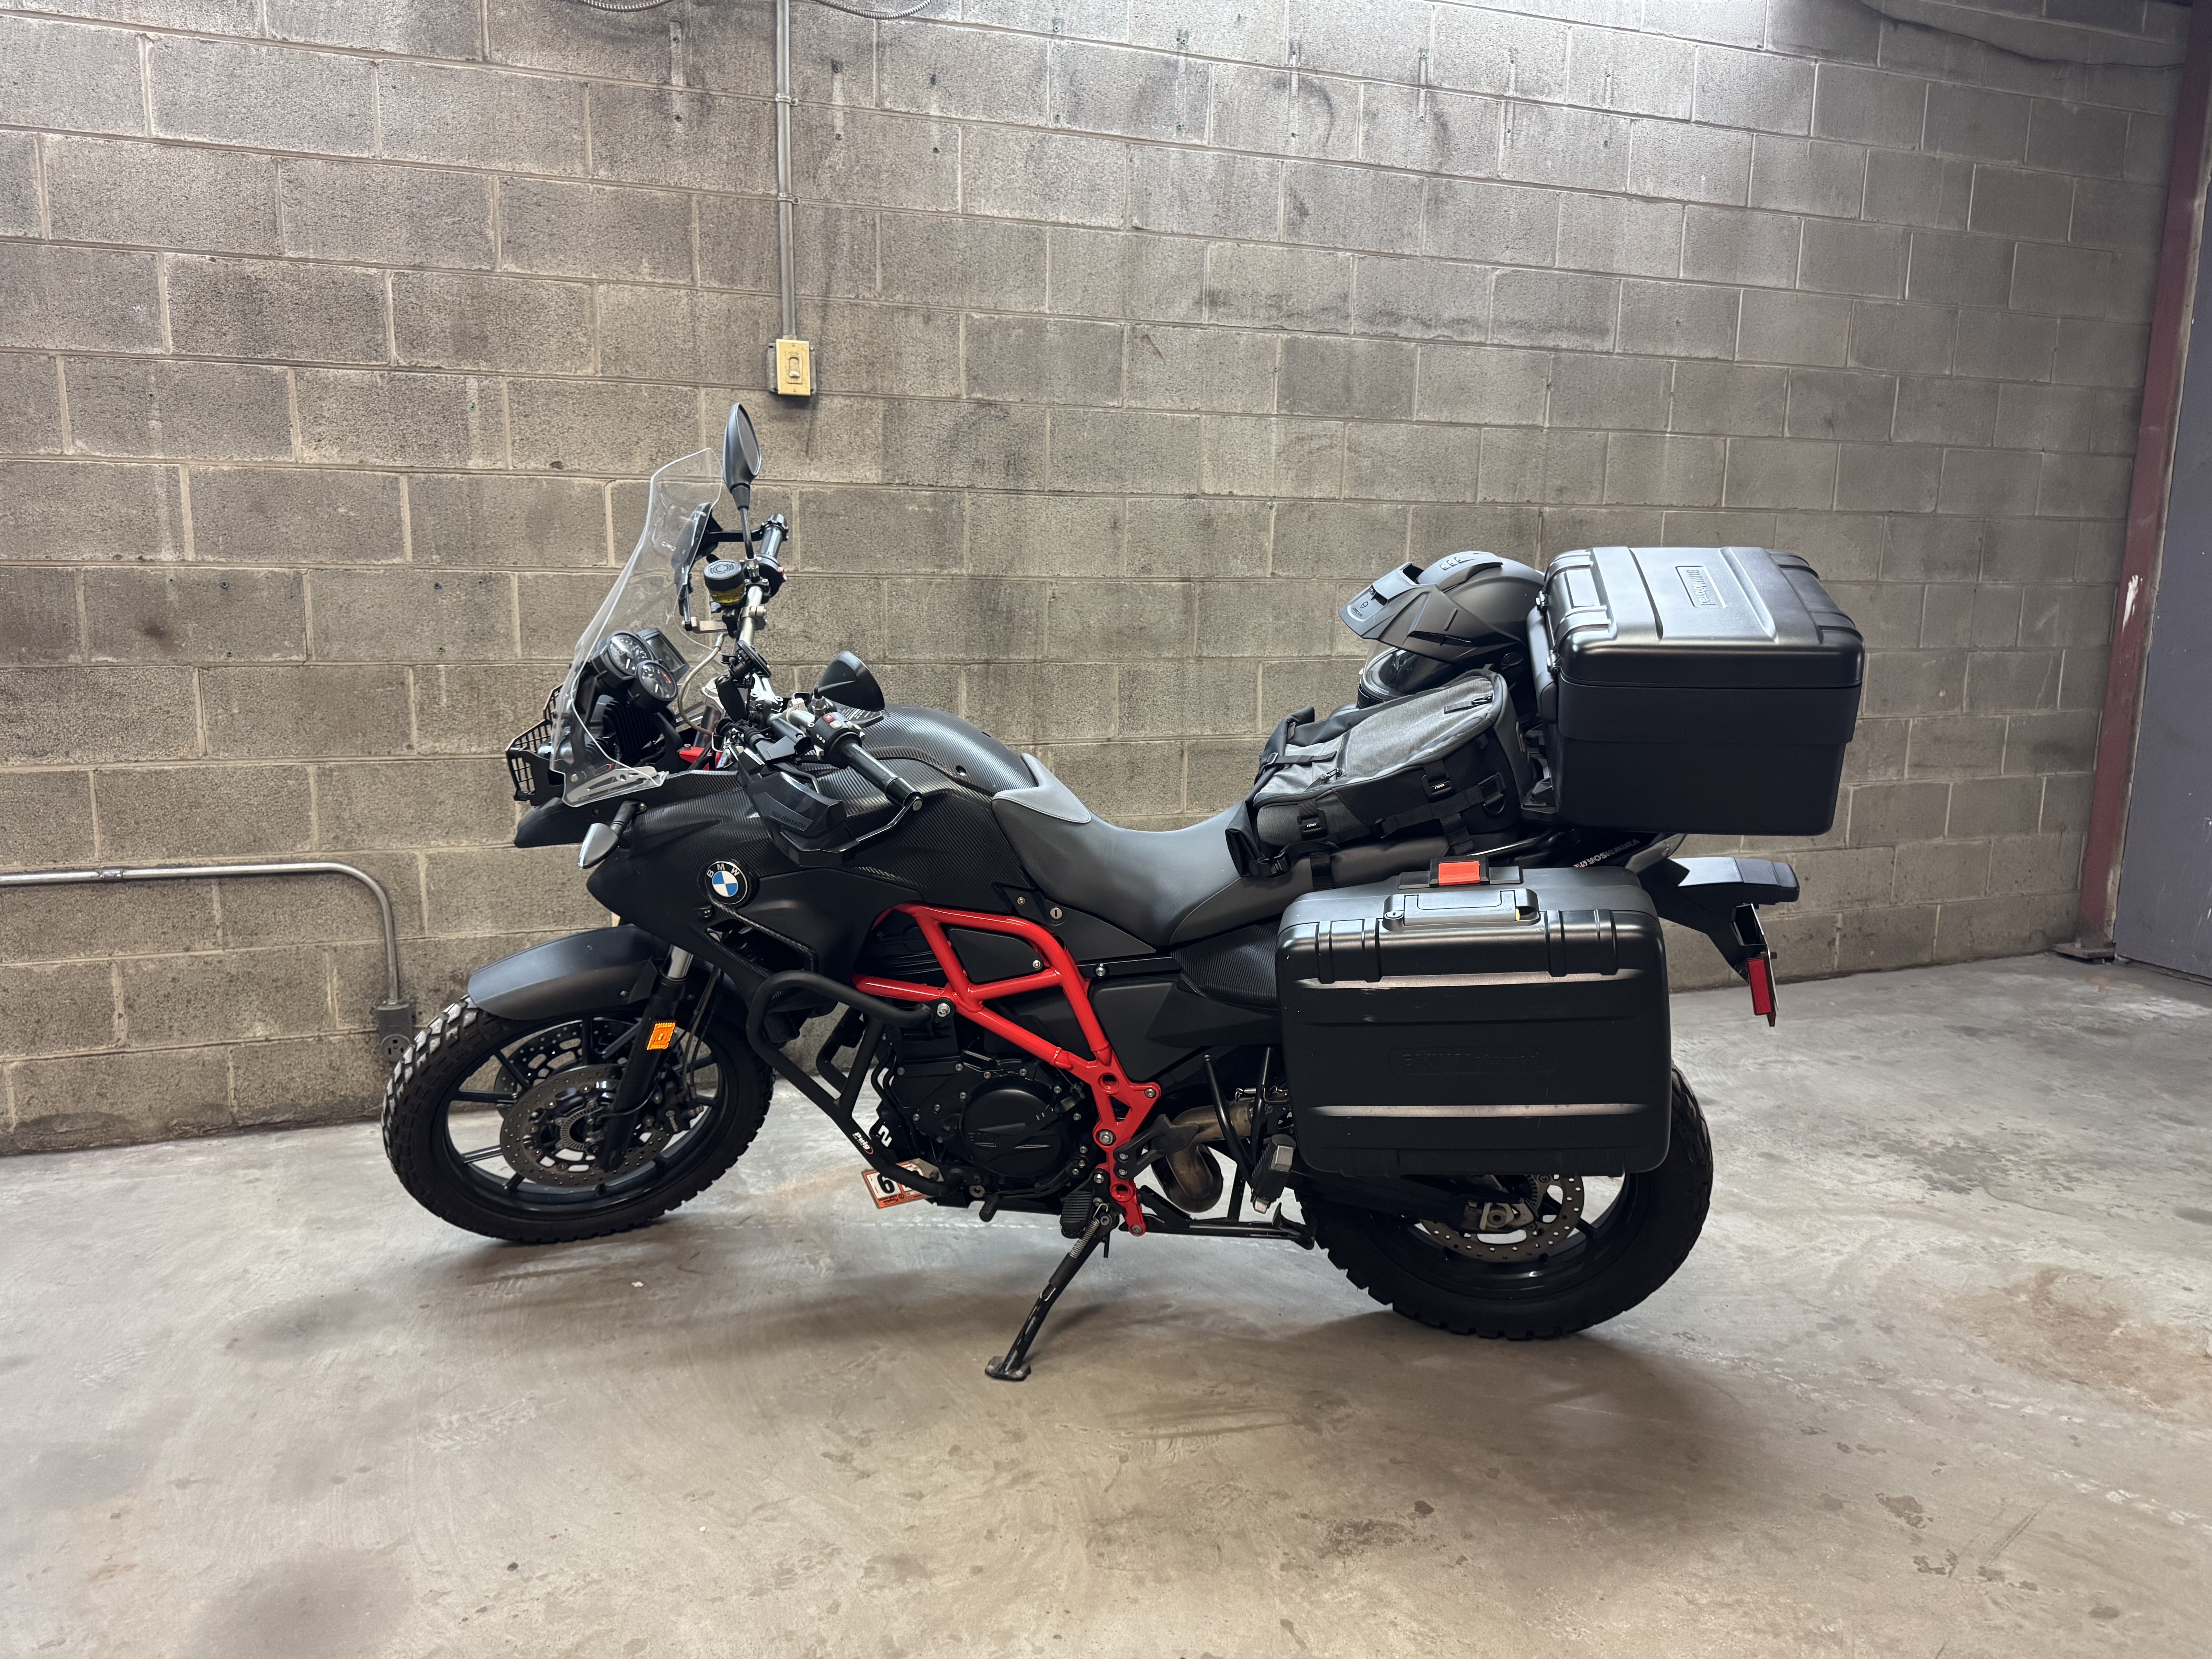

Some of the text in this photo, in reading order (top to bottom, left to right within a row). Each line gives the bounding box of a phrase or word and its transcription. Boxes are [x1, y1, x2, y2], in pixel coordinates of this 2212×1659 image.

[771, 811, 805, 828] SW-MOTECH
[707, 863, 740, 878] BMW
[854, 1132, 871, 1150] Puig
